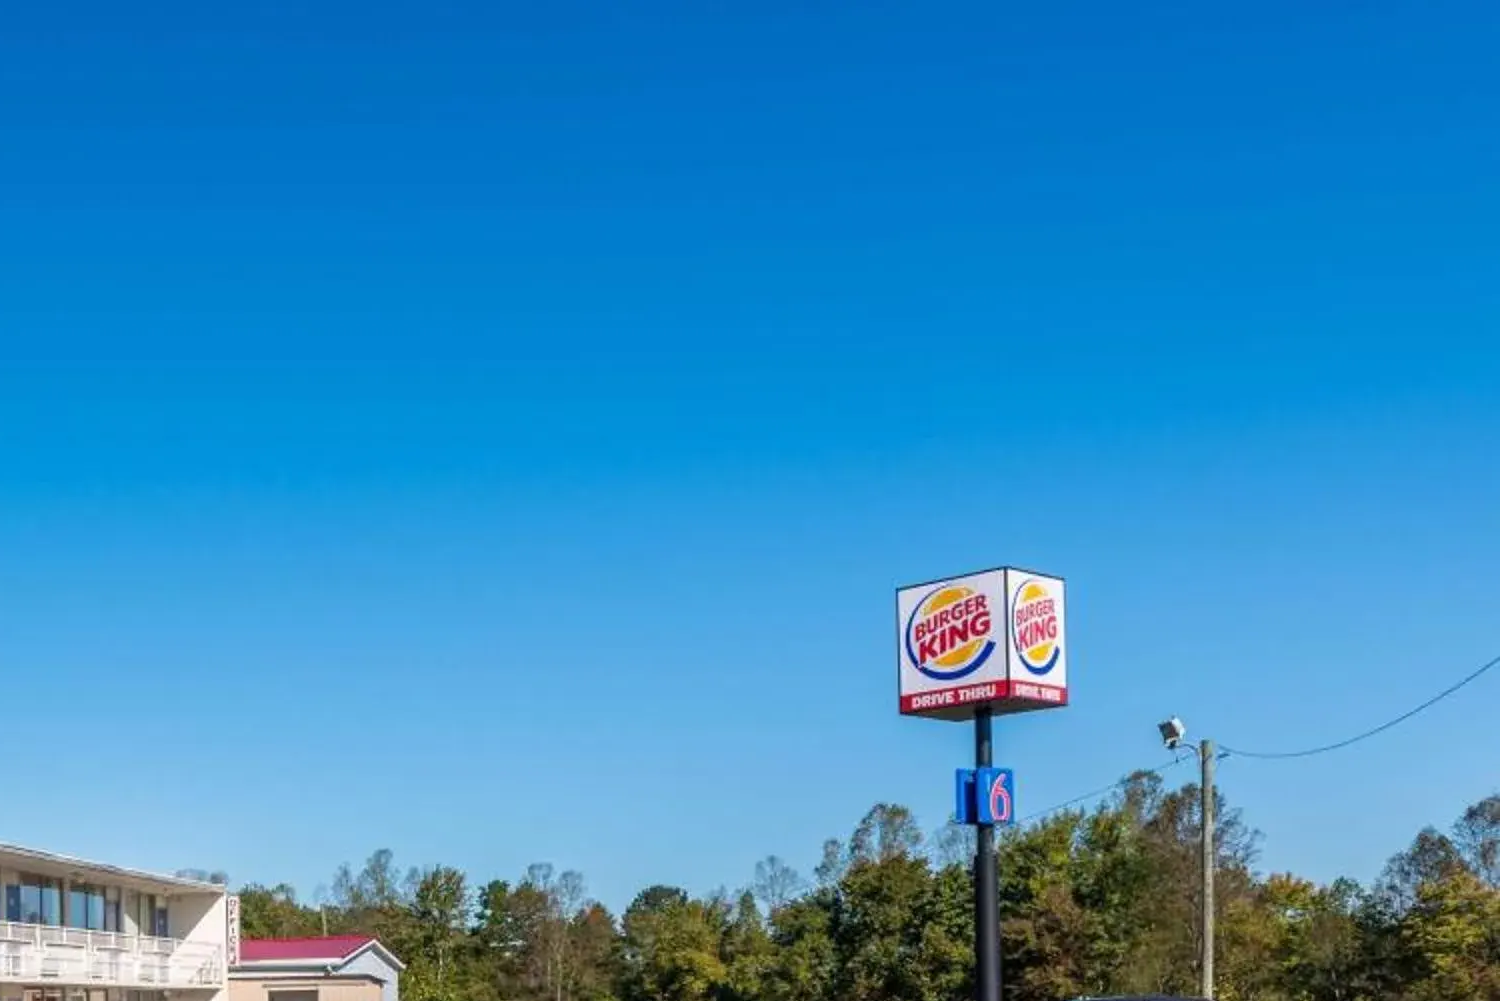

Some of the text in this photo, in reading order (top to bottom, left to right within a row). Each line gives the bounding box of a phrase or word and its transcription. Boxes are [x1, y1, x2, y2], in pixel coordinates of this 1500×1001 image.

[915, 595, 987, 642] BURGER
[1016, 600, 1055, 625] BURGER
[918, 611, 990, 664] KING
[1017, 616, 1057, 652] KING
[911, 691, 956, 709] DRIVE
[959, 684, 996, 700] THRU
[990, 773, 1011, 821] 6
